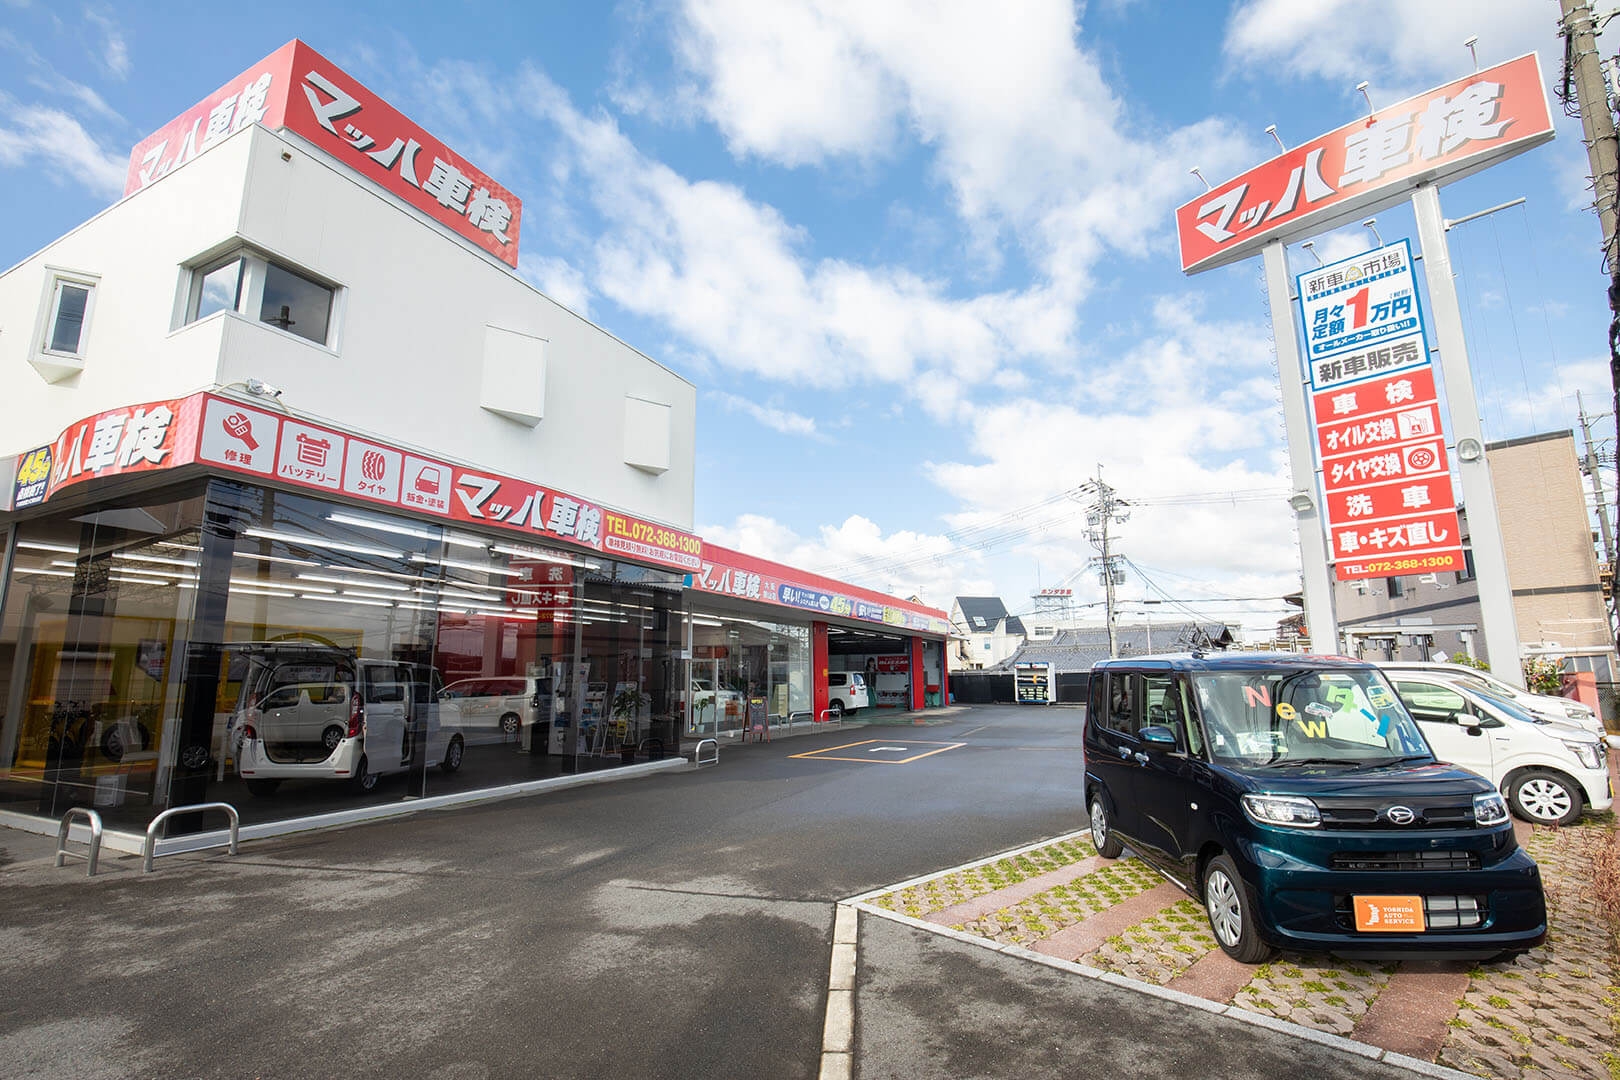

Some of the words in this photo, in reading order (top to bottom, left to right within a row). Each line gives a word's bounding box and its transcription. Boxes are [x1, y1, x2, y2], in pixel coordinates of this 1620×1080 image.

[301, 70, 513, 247] マッハ車検
[1195, 80, 1518, 244] マッハ車検
[1312, 318, 1346, 341] 定額
[1313, 304, 1346, 325] 月々
[1319, 340, 1419, 383] 新車販売
[1326, 418, 1397, 450] オイル交換
[224, 449, 253, 466] 修理
[1331, 453, 1402, 484] タイヤ交換
[281, 464, 337, 484] バッテリー
[357, 480, 387, 495] タイヤ
[455, 473, 602, 549] マッハ車検
[1339, 521, 1448, 553] 車・キズ直し
[697, 562, 762, 600] マッハ車検
